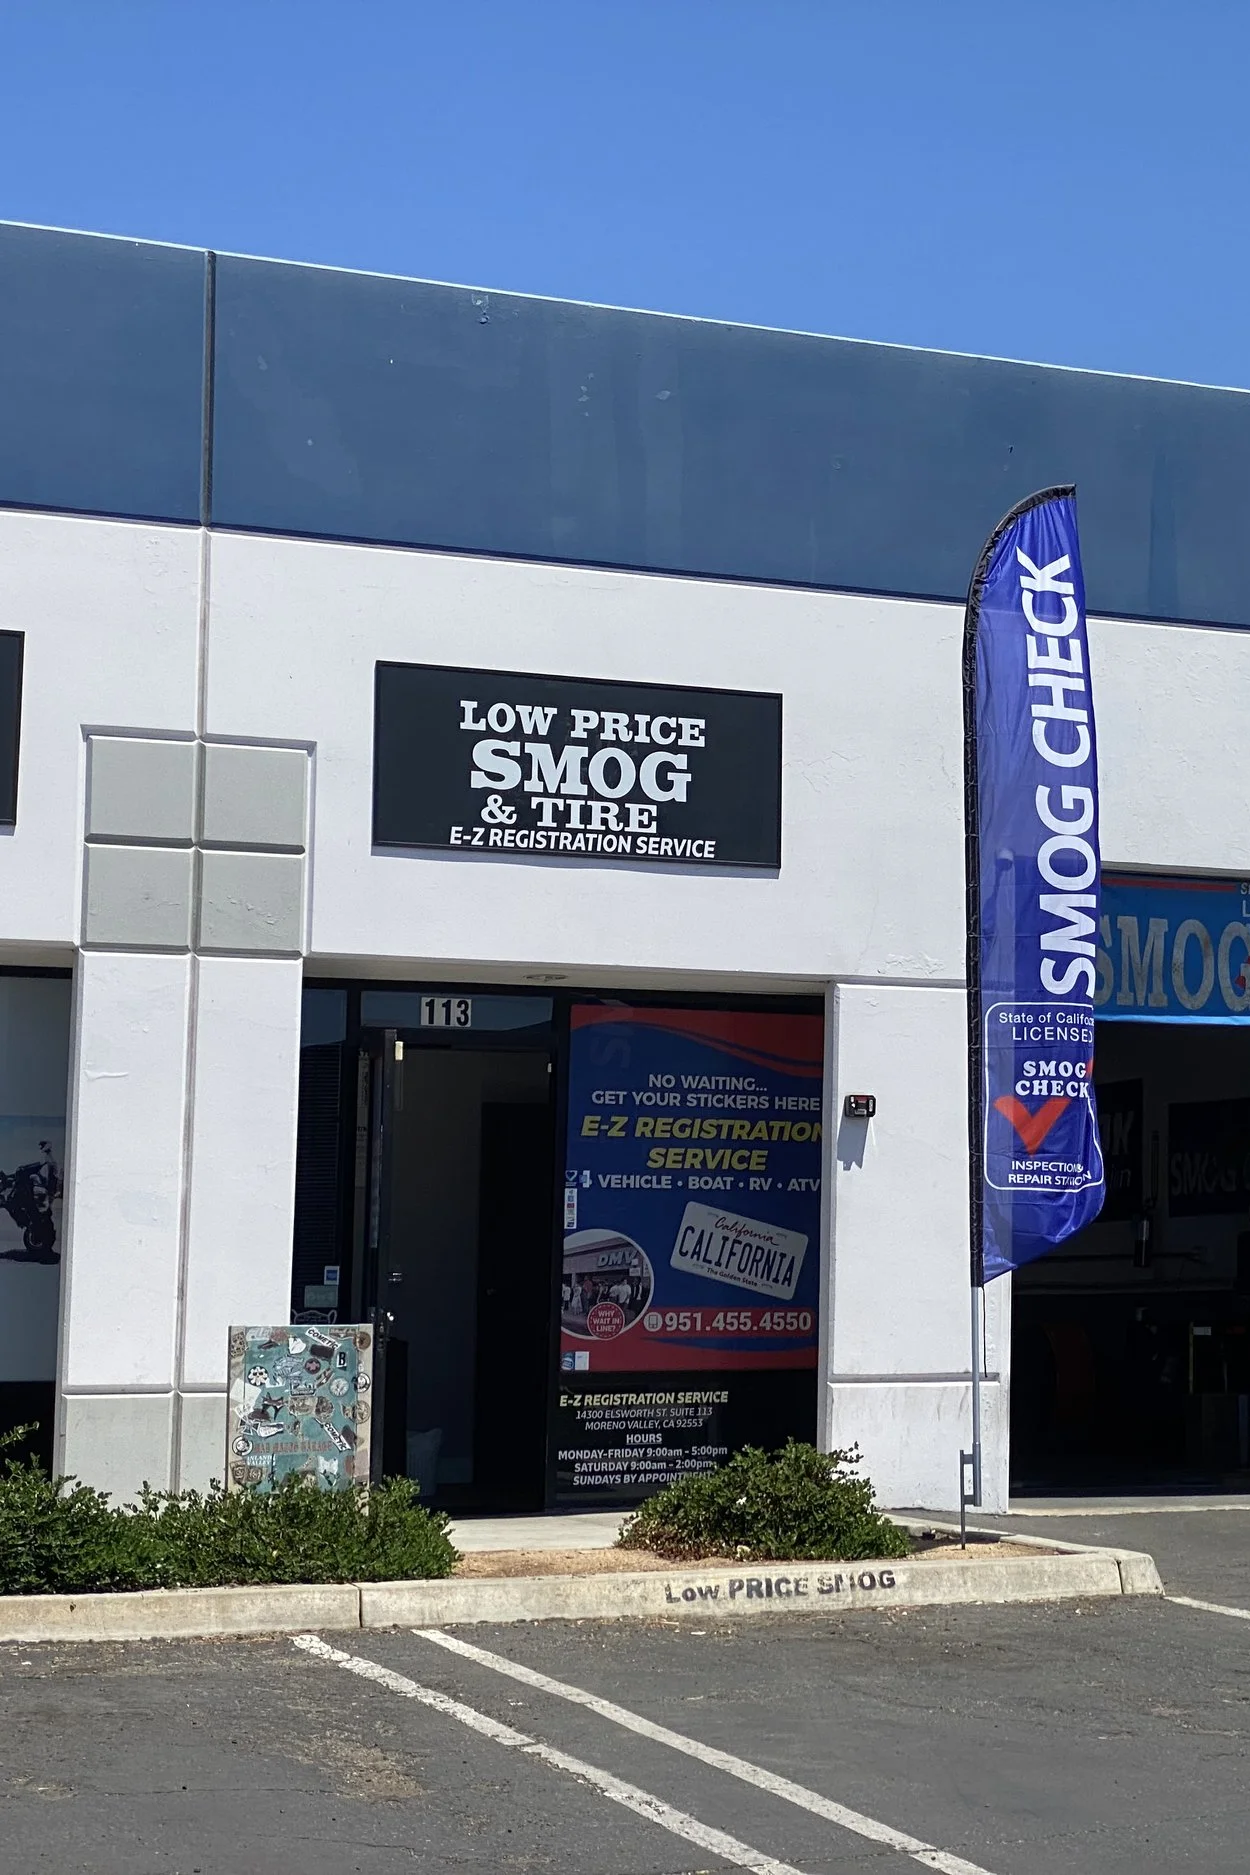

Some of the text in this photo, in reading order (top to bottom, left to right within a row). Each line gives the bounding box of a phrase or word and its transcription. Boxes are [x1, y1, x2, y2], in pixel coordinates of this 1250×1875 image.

[459, 700, 706, 748] LOW PRICE
[470, 739, 692, 804] SMOG
[1016, 546, 1096, 997] SMOG CHECK
[479, 794, 658, 835] & TIRE
[448, 826, 716, 859] E-Z REGISTRATION SERVICE
[425, 998, 470, 1026] 113
[998, 1012, 1034, 1025] State
[1038, 1012, 1052, 1024] of
[1022, 1060, 1087, 1078] SMOG
[648, 1073, 768, 1091] NO WAITING...
[1014, 1080, 1090, 1098] CHECK
[592, 1091, 820, 1111] GET YOUR STICKERS HERE
[581, 1115, 626, 1137] E-Z
[646, 1148, 768, 1171] SERVICE
[598, 1175, 820, 1192] VEHICLE BOAT RV ATV
[1008, 1173, 1052, 1185] REPAIR
[714, 1216, 779, 1246] California
[597, 1249, 638, 1267] DMV
[678, 1225, 796, 1287] CALIFORNIA
[706, 1267, 758, 1287] The Golden State
[592, 1317, 610, 1325] WAIT
[665, 1311, 812, 1332] 951.455.4550
[559, 1391, 728, 1407] E-Z REGISTRATION SERVICE
[576, 1407, 713, 1419] 14300 ELSWORTH ST. SUITE 113
[585, 1419, 703, 1431] MORENO VALLEY, CA 92553
[626, 1433, 662, 1443] HOURS
[558, 1448, 645, 1460] MONDAY-FRIDAY
[647, 1447, 682, 1457] 9:00am
[691, 1446, 728, 1458] 5:00pm
[574, 1462, 629, 1473] SATURDAY
[630, 1460, 666, 1471] 9:00am
[676, 1459, 713, 1471] 2:00pm
[573, 1474, 621, 1485] SUNDAYS
[623, 1473, 637, 1484] BY
[728, 1577, 809, 1600] PRICE
